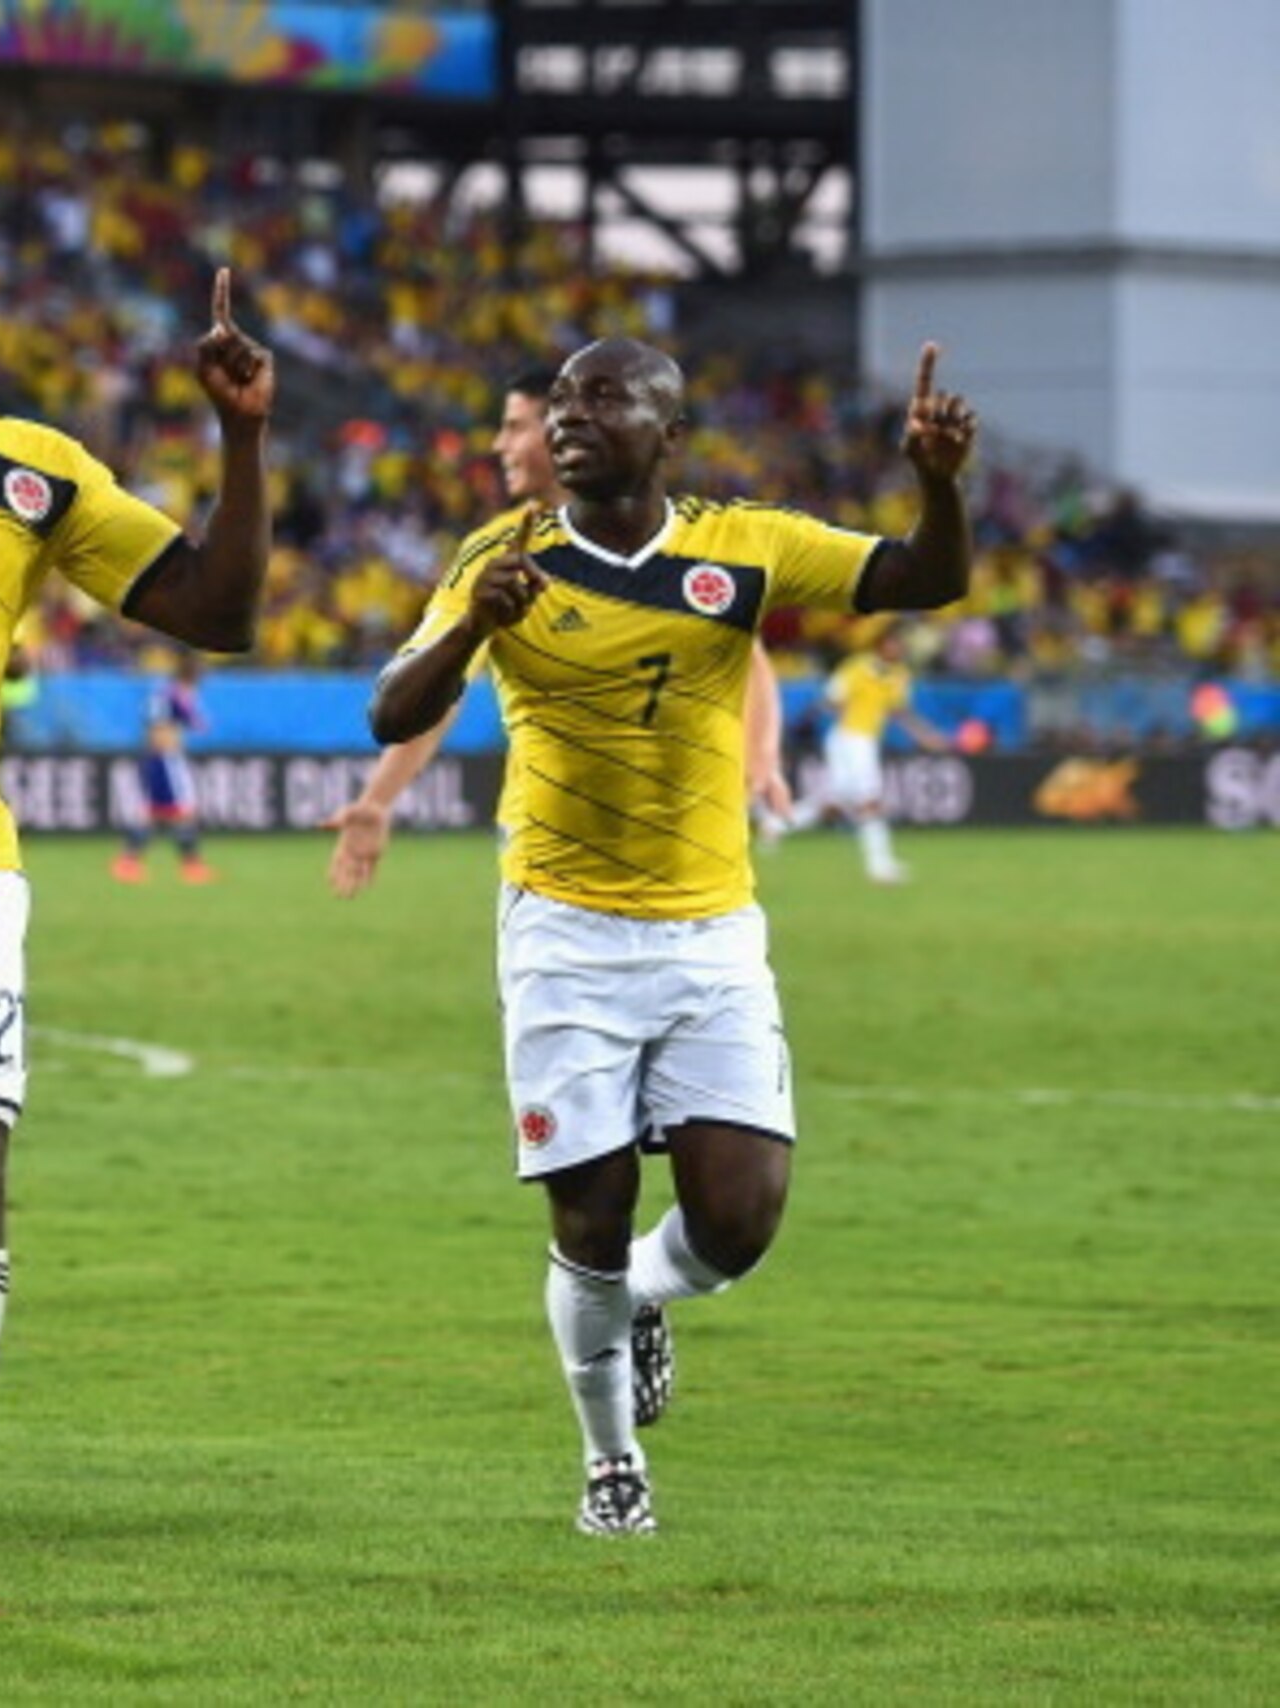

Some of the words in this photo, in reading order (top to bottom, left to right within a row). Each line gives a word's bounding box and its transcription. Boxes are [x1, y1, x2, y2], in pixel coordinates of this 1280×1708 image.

[637, 652, 671, 728] 7
[108, 756, 275, 830] MRE
[1206, 746, 1280, 831] S
